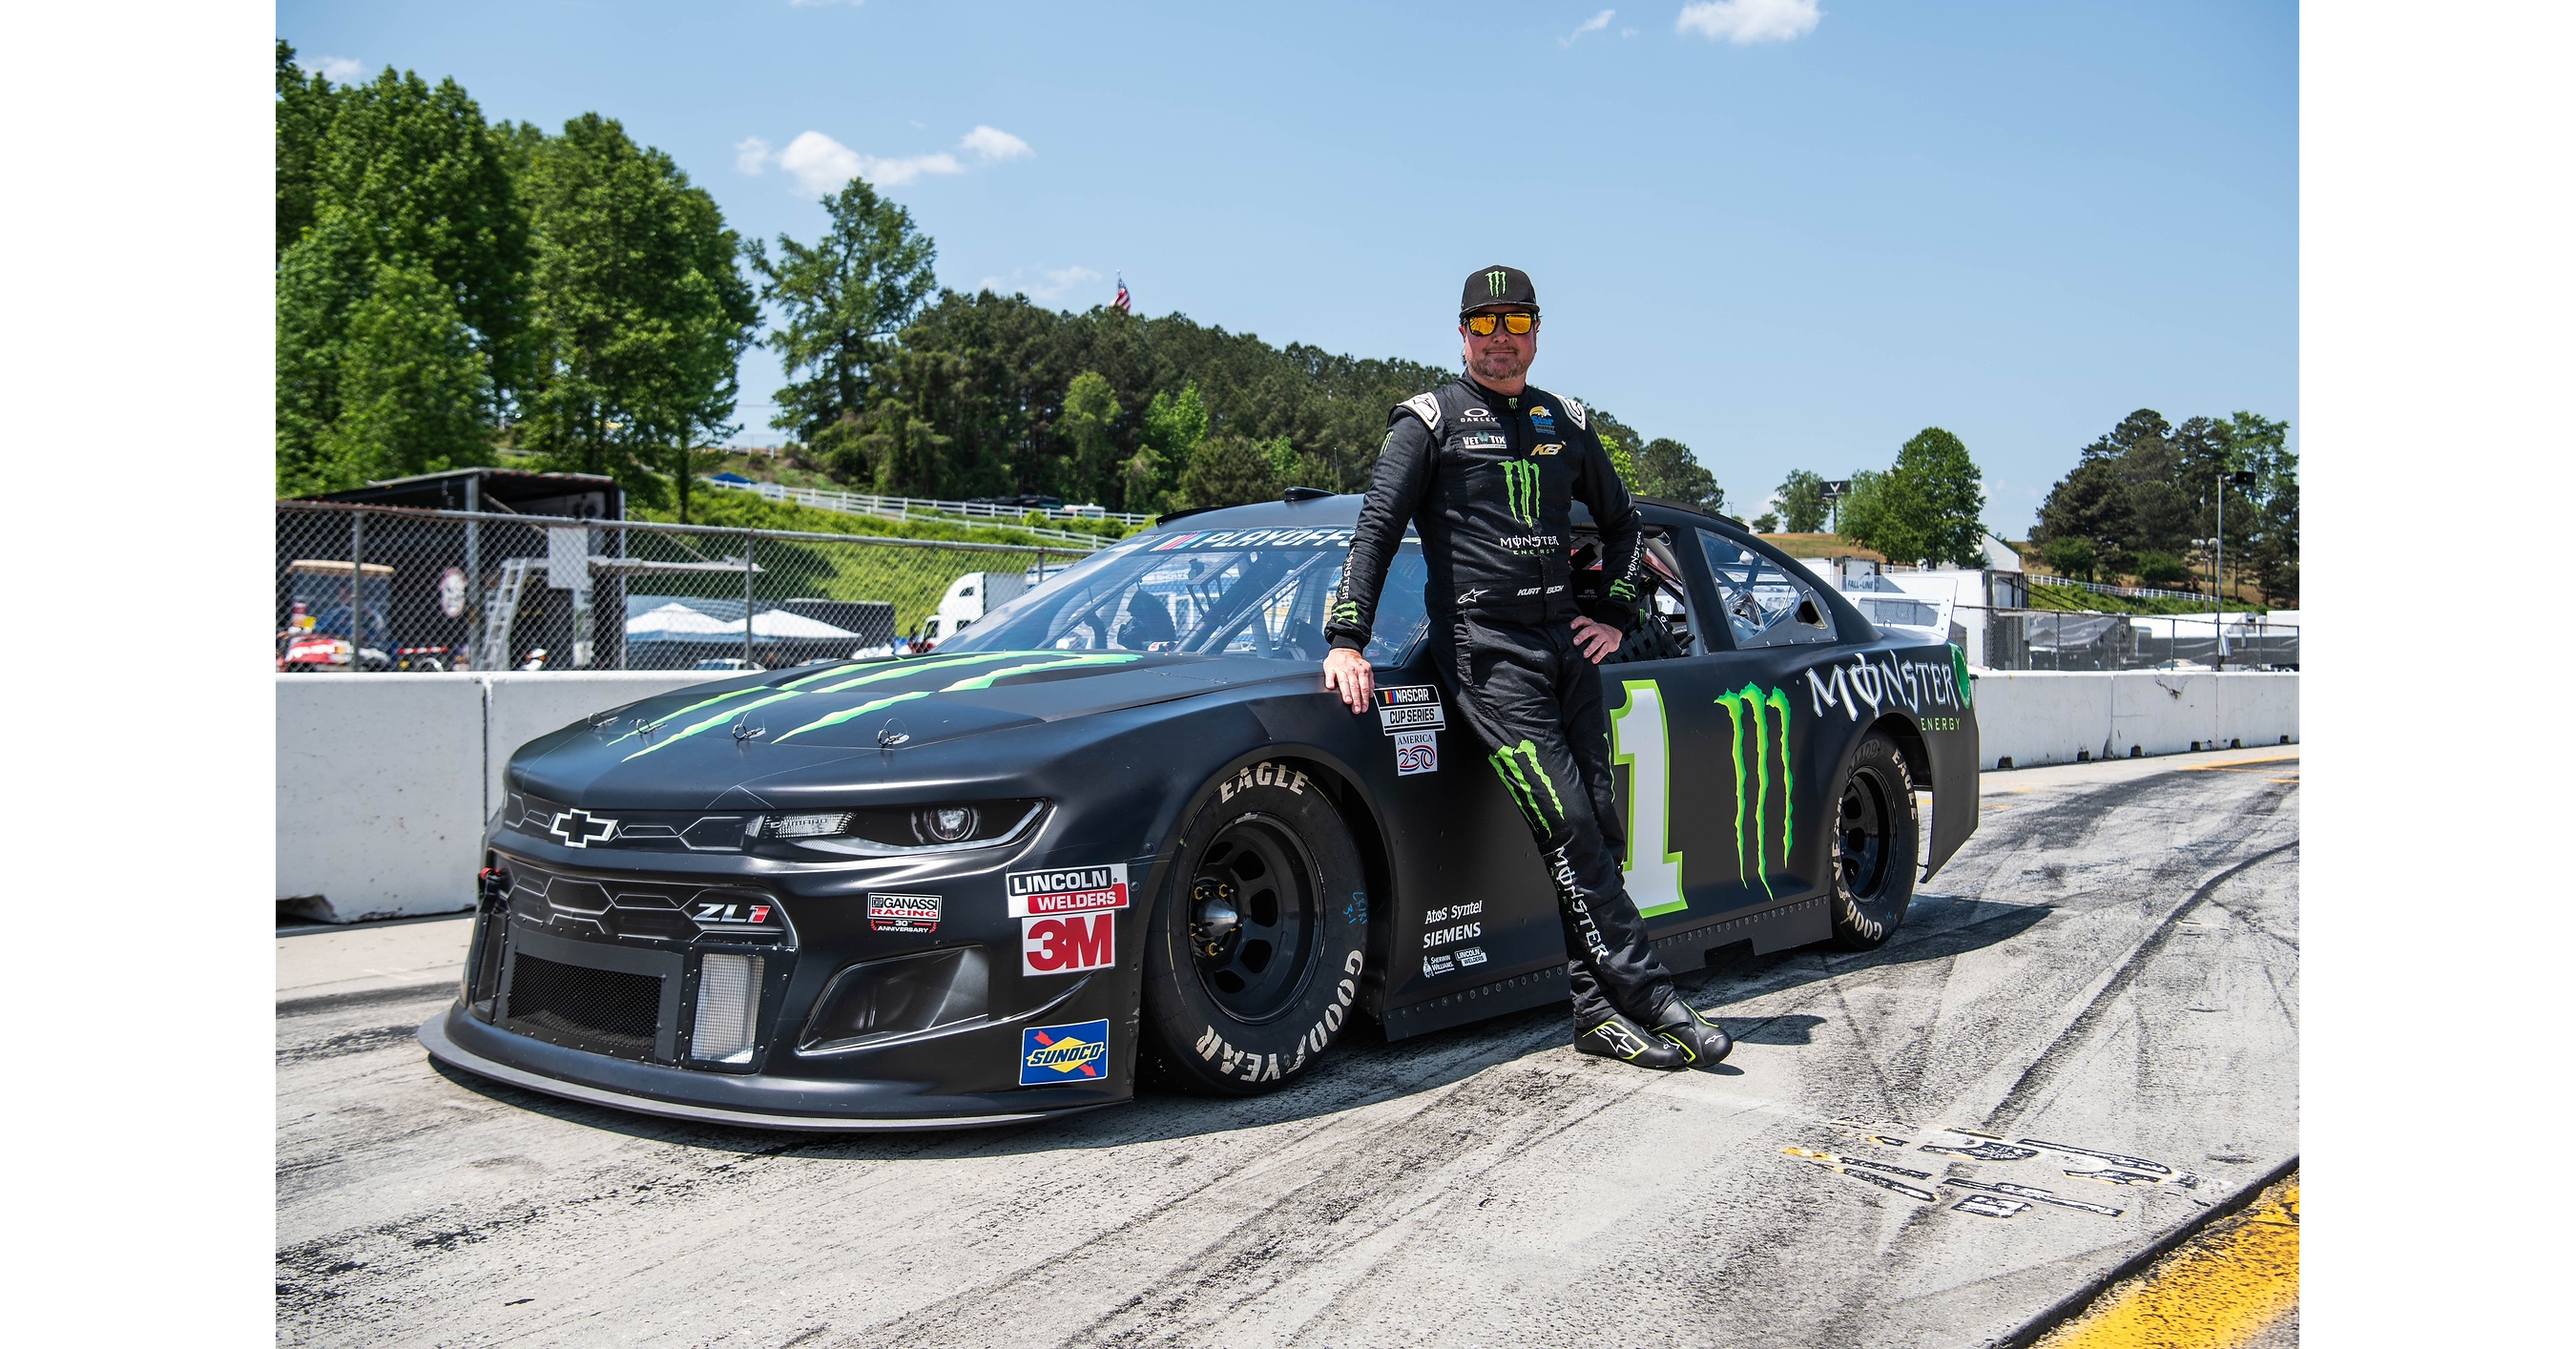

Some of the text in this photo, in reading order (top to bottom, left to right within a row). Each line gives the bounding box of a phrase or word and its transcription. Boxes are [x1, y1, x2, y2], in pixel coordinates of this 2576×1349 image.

[1463, 435, 1506, 446] VET TIX
[1500, 535, 1559, 549] MONSTER
[1517, 587, 1542, 596] KURT
[1805, 650, 1960, 721] MONSTER
[1395, 688, 1430, 703] NASCAR
[1389, 708, 1435, 724] CUP SERIES
[1921, 717, 1961, 731] ENERGY
[1397, 734, 1433, 745] AMERICA
[1220, 761, 1309, 804] EAGLE
[1892, 748, 1918, 820] EAGLE
[1013, 869, 1108, 894] LINCOLN
[884, 898, 938, 910] GANASSI
[1037, 891, 1116, 911] WELDERS
[1451, 900, 1483, 920] Syntel
[692, 903, 771, 924] ZL1
[871, 908, 937, 917] RACING
[1027, 914, 1113, 971] 3M
[1423, 922, 1482, 948] SIEMENS
[1456, 948, 1481, 960] LINCOLN
[1030, 1044, 1103, 1066] SUNOCO
